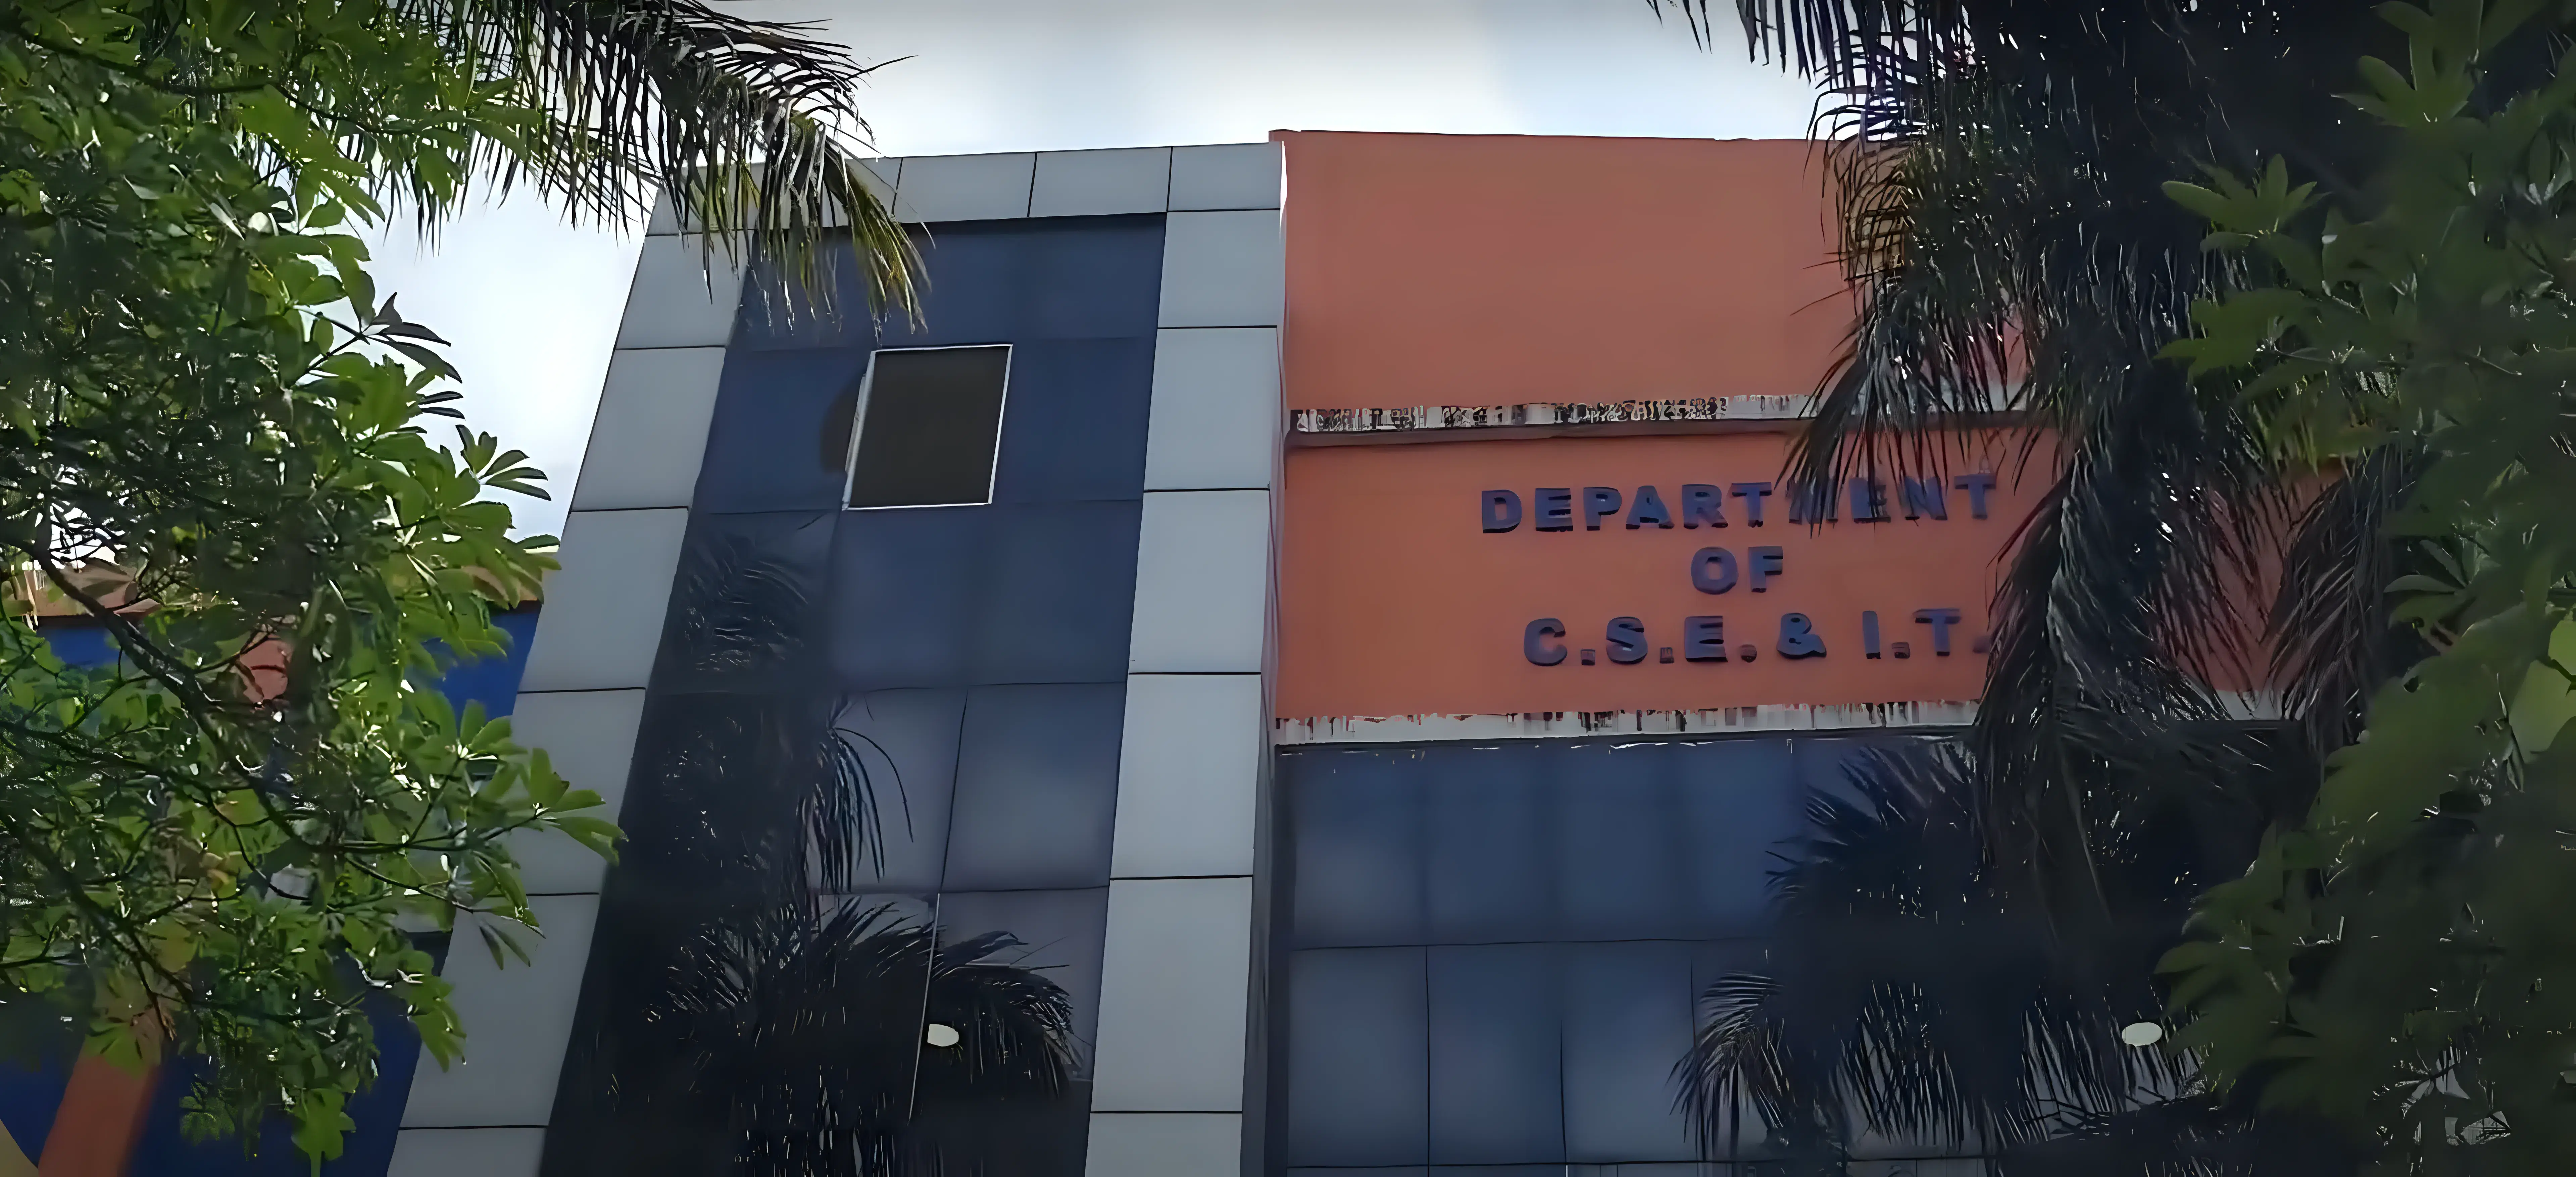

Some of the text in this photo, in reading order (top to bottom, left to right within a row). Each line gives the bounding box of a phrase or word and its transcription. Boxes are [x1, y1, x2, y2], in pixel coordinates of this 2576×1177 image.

[1691, 546, 1783, 595] OF
[1524, 615, 1757, 666] C.S.E.
[1776, 612, 1827, 660] &
